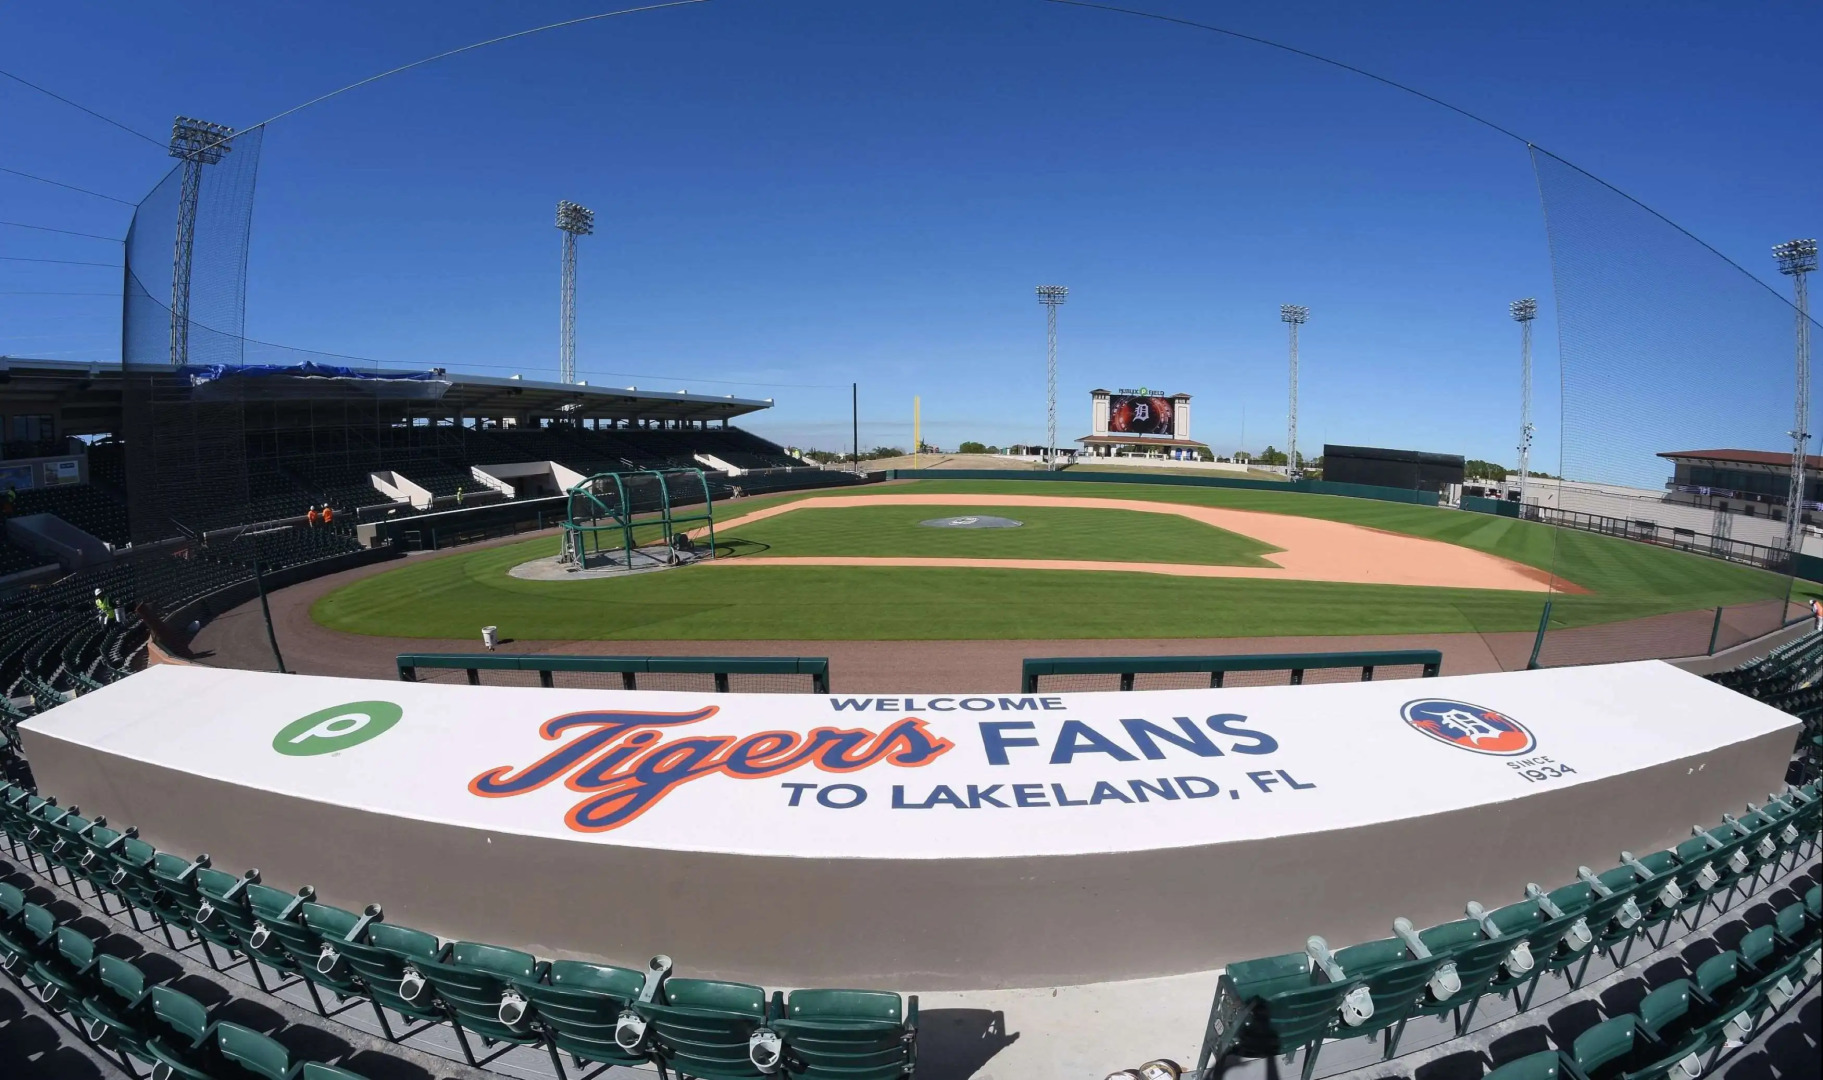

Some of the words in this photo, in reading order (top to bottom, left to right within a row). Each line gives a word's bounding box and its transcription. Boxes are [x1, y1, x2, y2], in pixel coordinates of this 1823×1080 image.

[830, 698, 1067, 711] WELCOME
[468, 706, 954, 833] Tigers
[979, 714, 1278, 765] FANS
[1506, 756, 1555, 769] SINCE
[1518, 763, 1577, 783] 1934
[781, 783, 867, 809] TO
[892, 776, 1239, 809] LAKELAND,
[1246, 770, 1316, 792] FL
